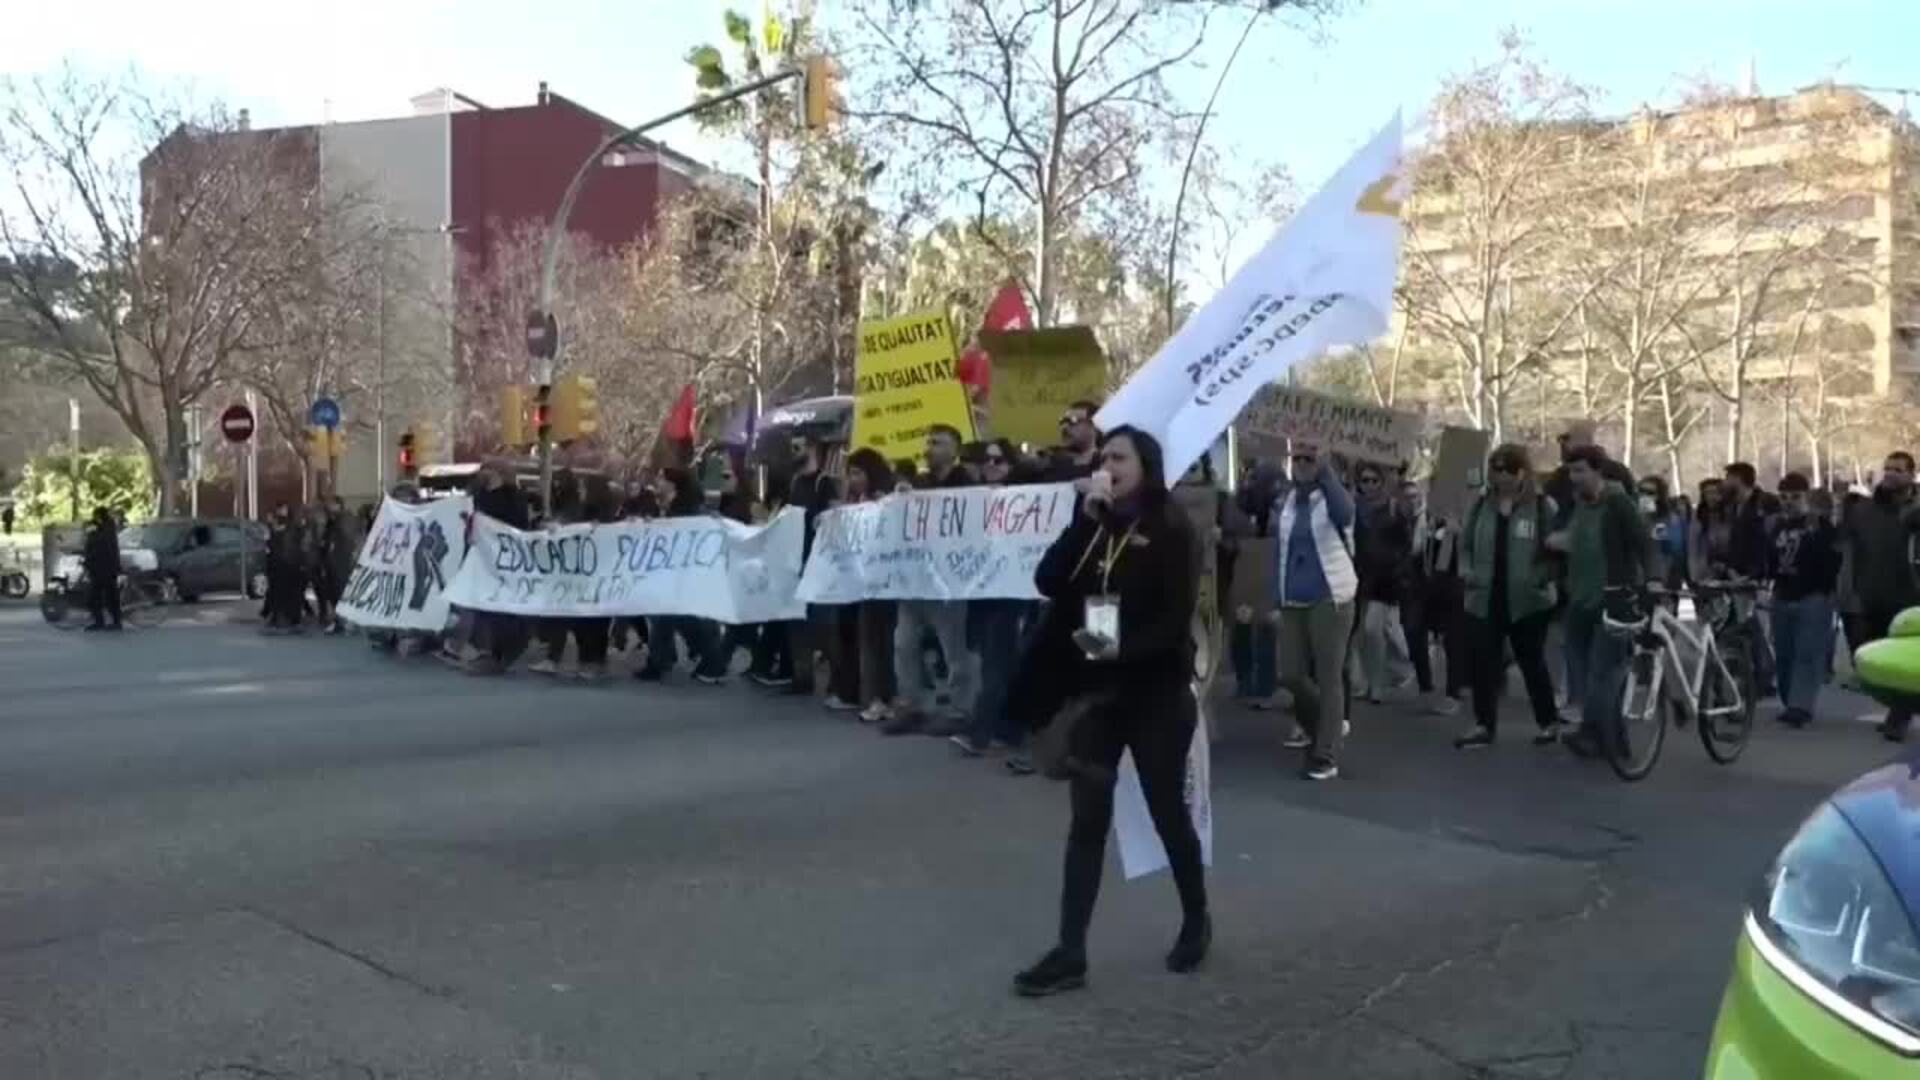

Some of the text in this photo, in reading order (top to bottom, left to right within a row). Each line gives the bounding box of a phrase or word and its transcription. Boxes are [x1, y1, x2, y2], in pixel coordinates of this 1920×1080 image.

[878, 318, 945, 352] QUALITAT
[939, 498, 967, 537] EN
[982, 491, 1059, 536] VAGA!
[496, 527, 731, 577] EDUCACIÓ PÚBLICA
